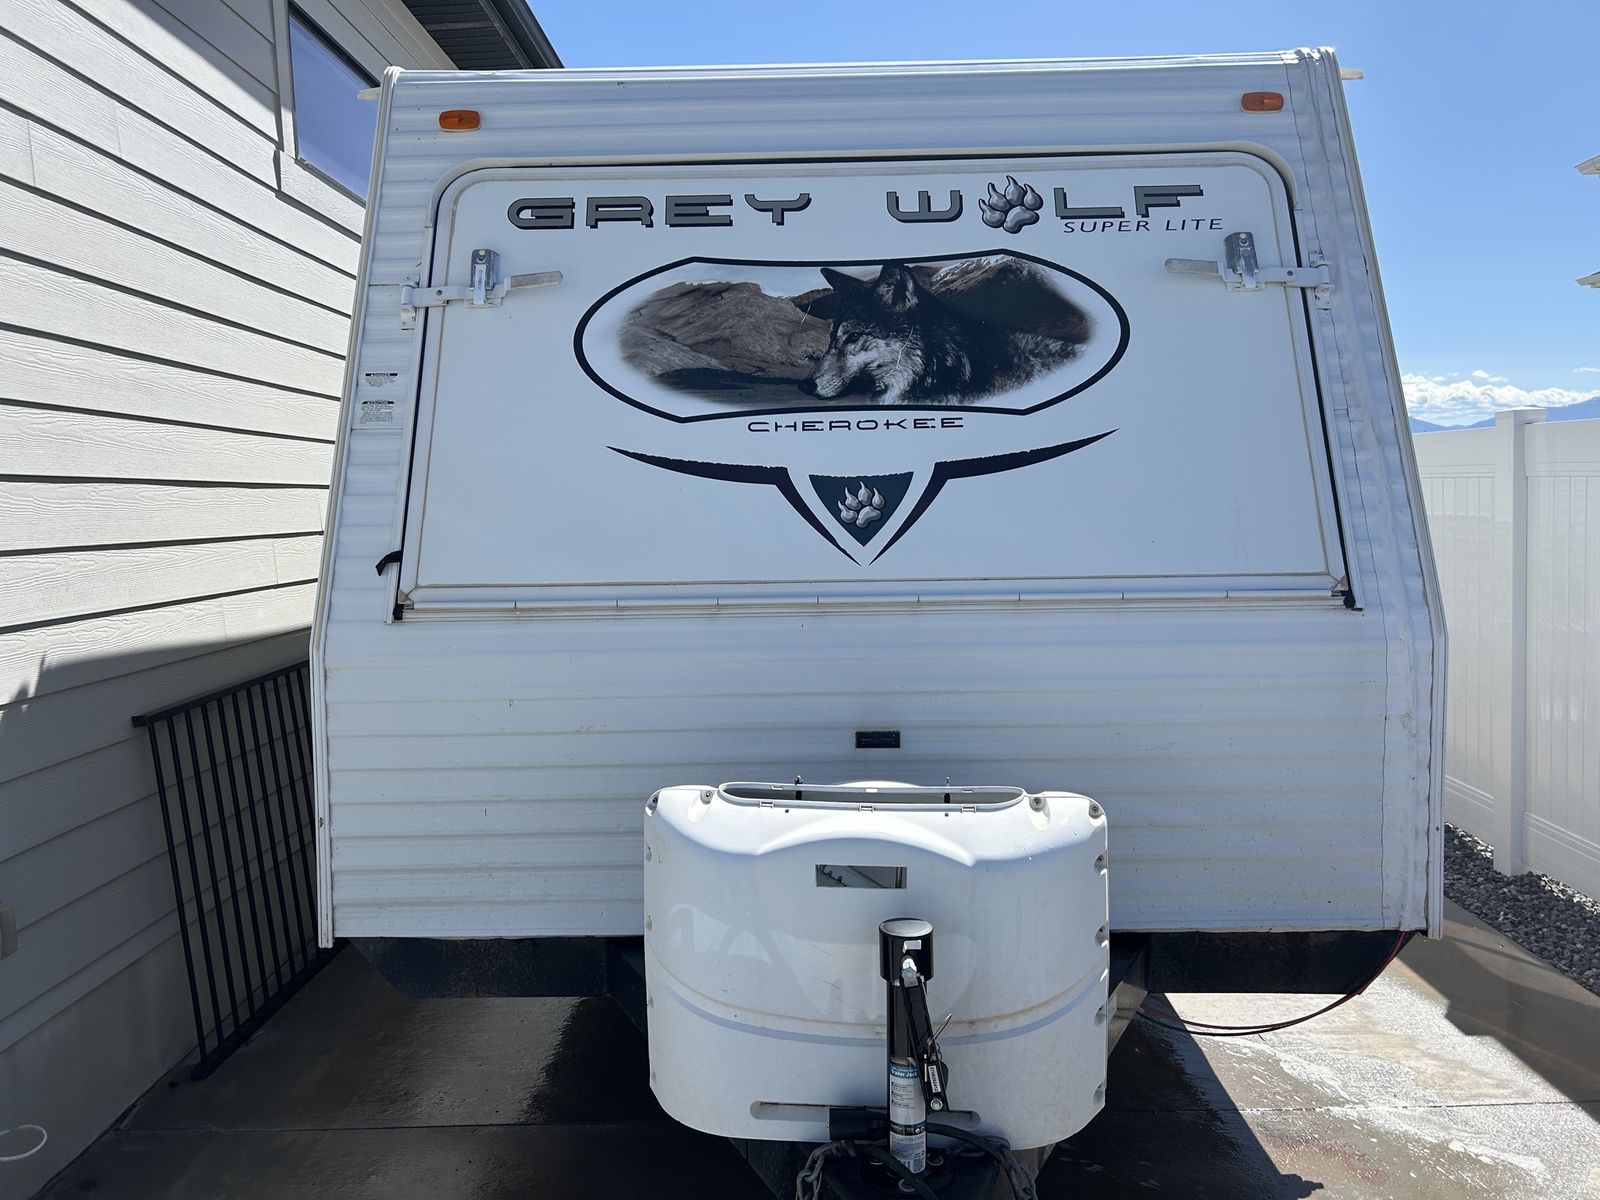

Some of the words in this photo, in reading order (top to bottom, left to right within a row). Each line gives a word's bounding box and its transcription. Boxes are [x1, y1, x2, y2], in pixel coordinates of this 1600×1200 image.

[507, 193, 812, 229] GREY
[886, 175, 1204, 234] WLF
[1063, 220, 1150, 233] SUPER
[1165, 218, 1224, 231] LITE
[747, 417, 964, 432] CHEROKEE
